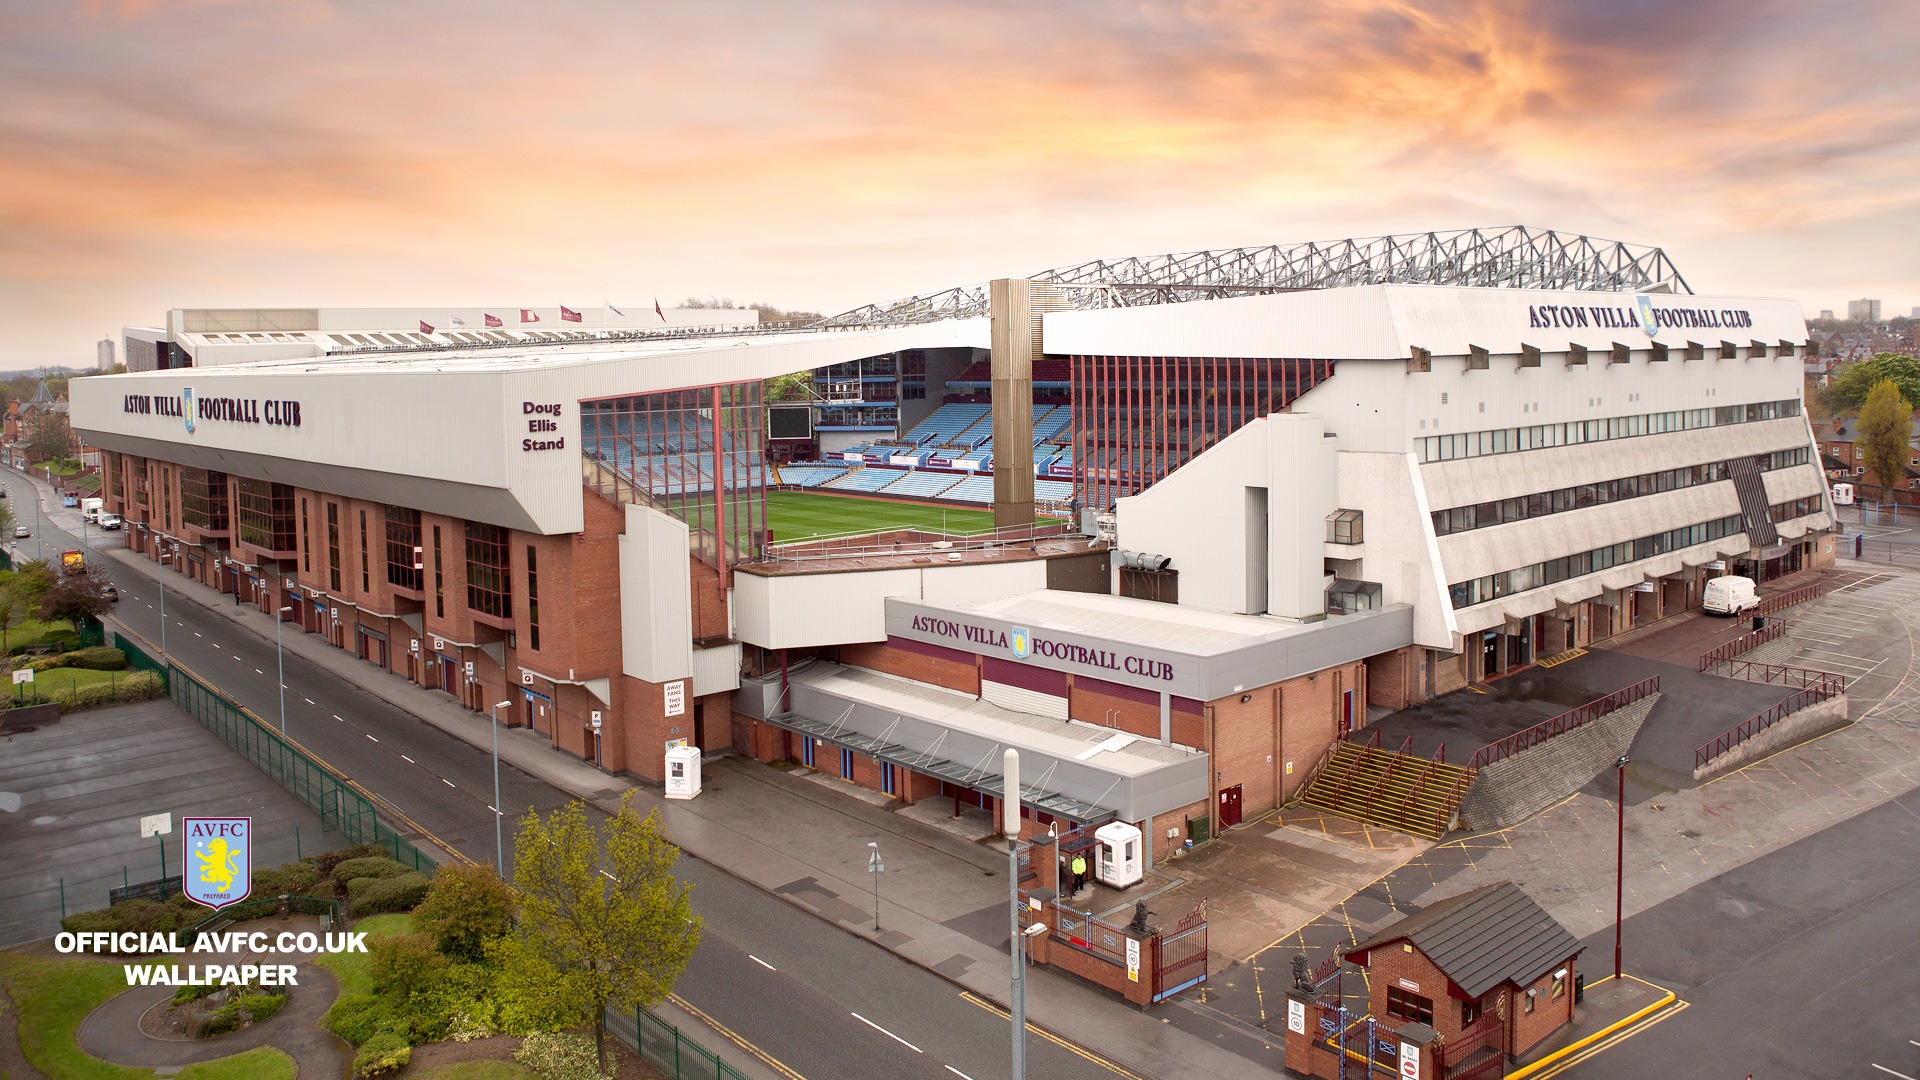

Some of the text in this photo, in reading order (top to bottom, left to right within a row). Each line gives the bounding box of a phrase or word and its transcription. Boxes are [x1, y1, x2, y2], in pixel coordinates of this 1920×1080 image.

[1529, 305, 1752, 328] ASTON VILLA FOOTBALL CLUB
[124, 394, 302, 427] ASTON VILLA FOOTBALL CLUB
[523, 401, 562, 416] Doug
[528, 419, 557, 432] Ellis
[522, 436, 565, 451] Stand
[912, 615, 1174, 681] ASTON VILLA FOOTBALL CLUB
[1293, 1020, 1300, 1028] 10
